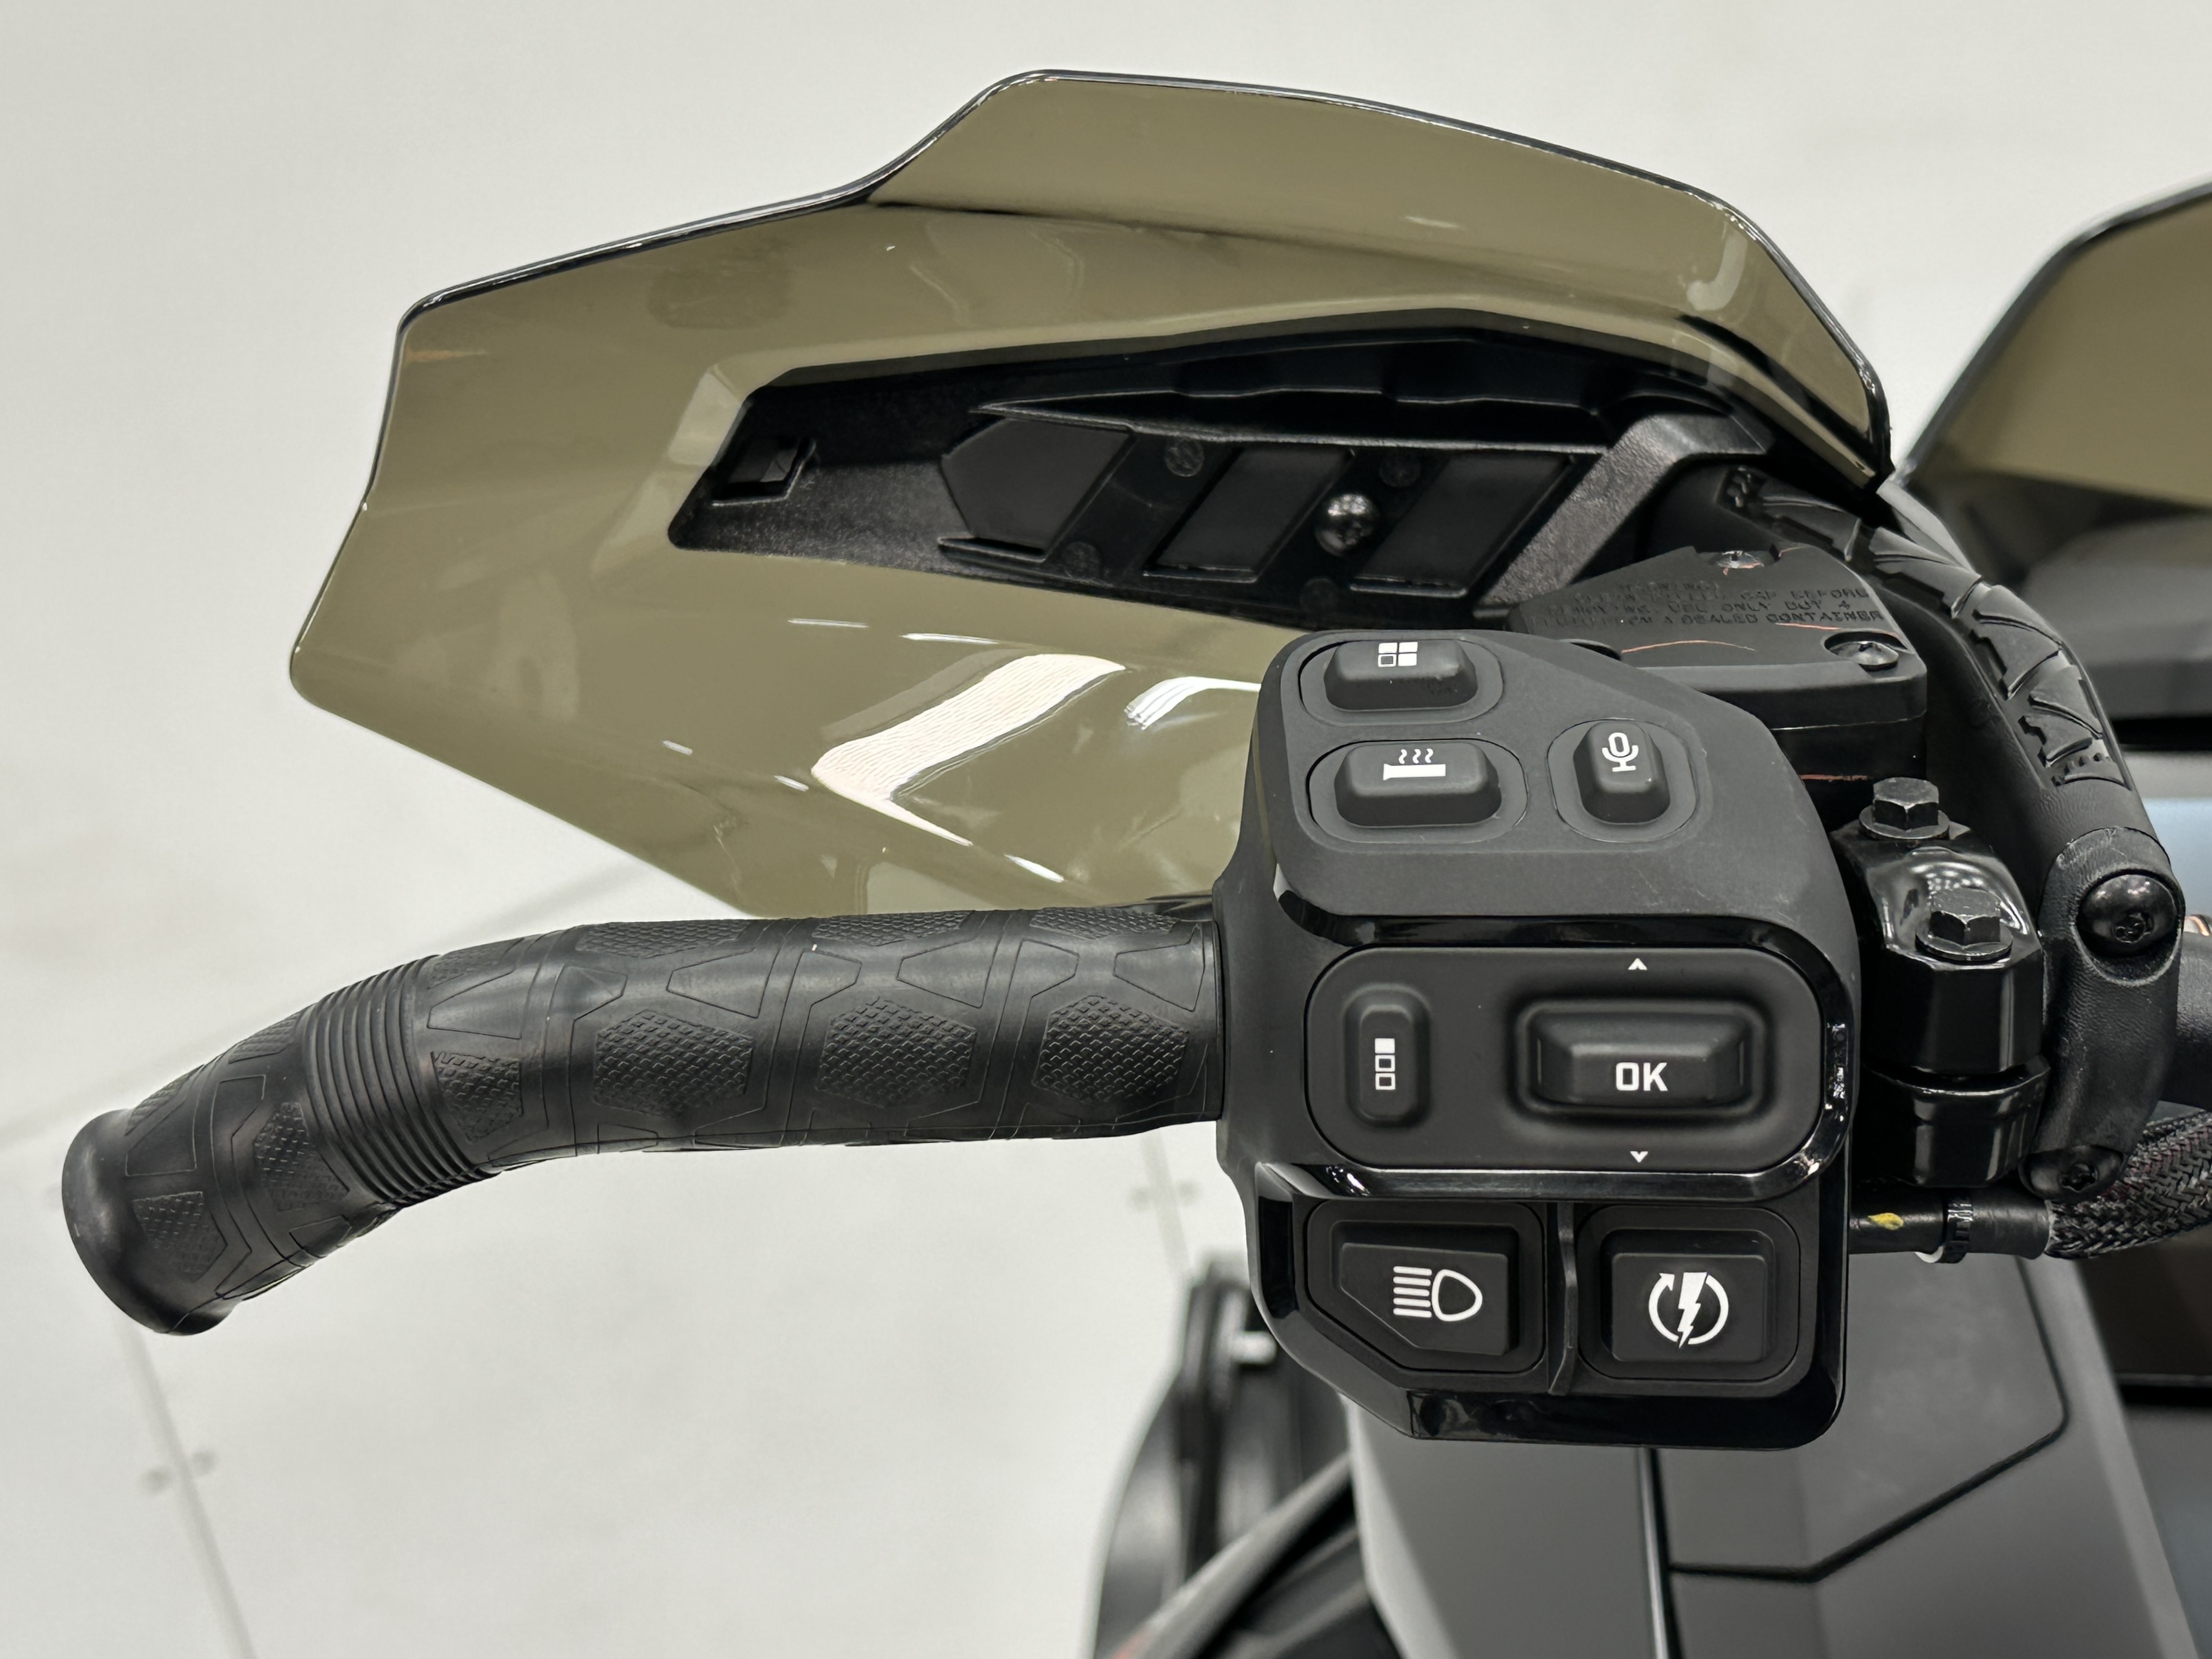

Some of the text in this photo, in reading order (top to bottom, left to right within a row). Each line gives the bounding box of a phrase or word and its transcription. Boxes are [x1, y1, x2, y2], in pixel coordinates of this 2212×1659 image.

[1721, 601, 1771, 612] ONLY
[1767, 611, 1884, 623] CONTAINER
[1616, 1061, 1669, 1092] OK
